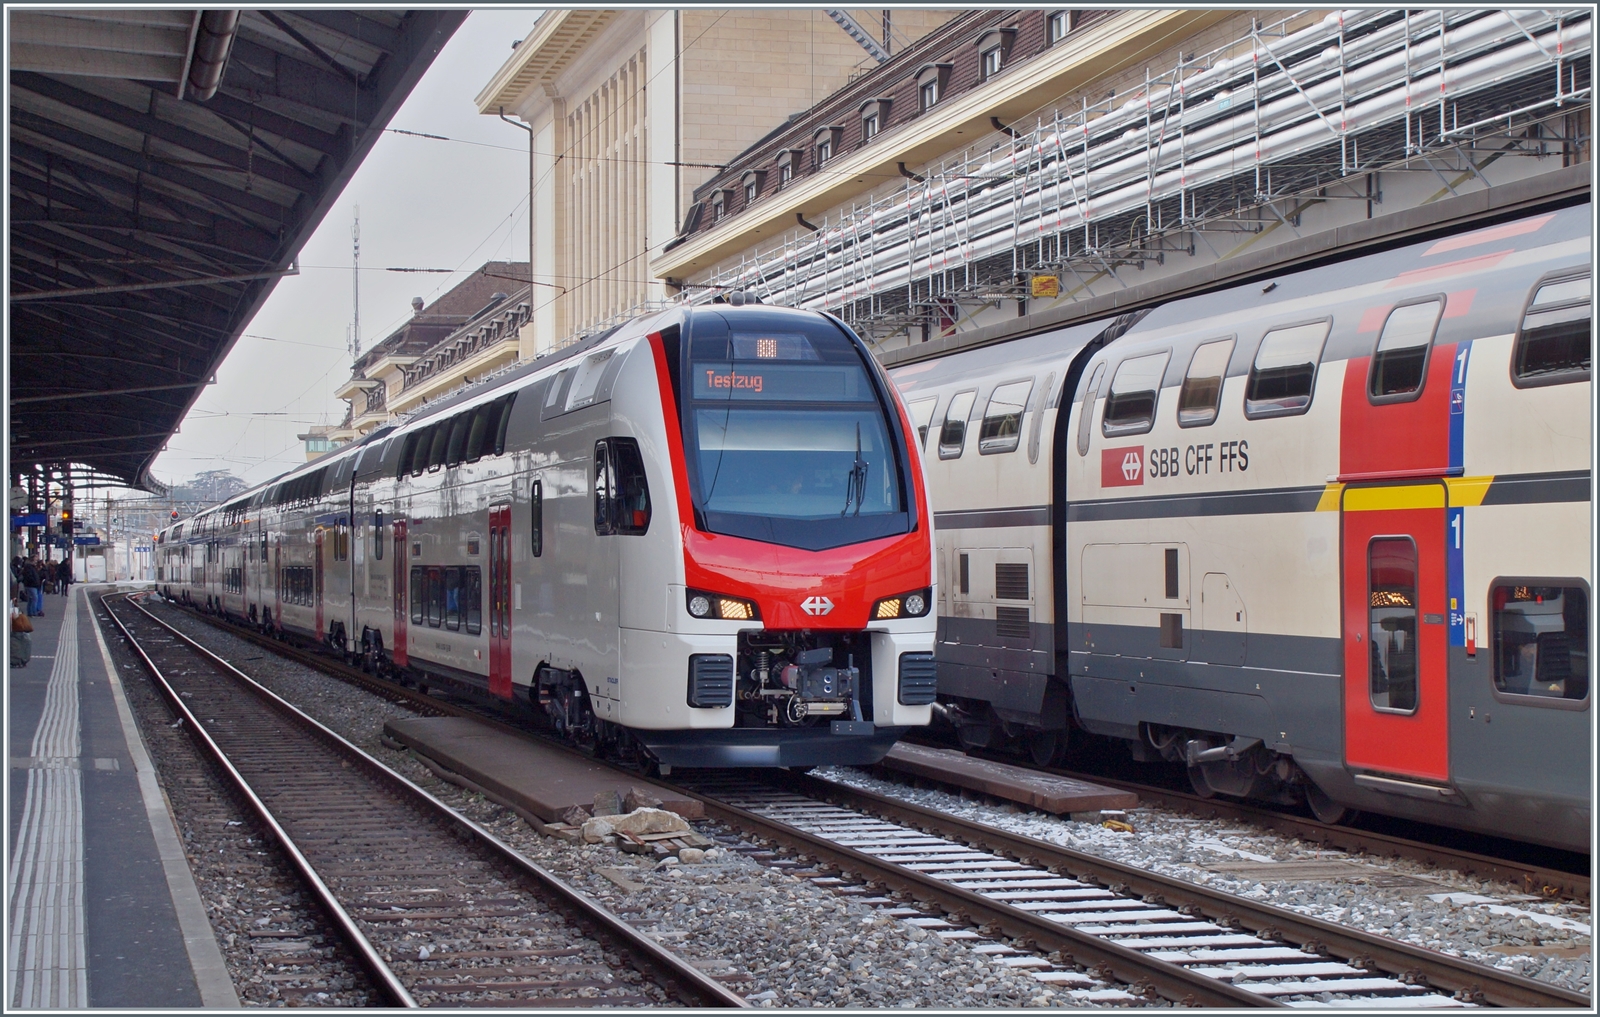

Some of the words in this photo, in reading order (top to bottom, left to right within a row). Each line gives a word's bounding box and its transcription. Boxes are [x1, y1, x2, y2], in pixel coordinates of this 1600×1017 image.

[706, 370, 763, 392] Testzug
[1457, 348, 1467, 384] 1
[1150, 448, 1179, 478] SBB
[1185, 444, 1213, 476] CFF
[1220, 440, 1249, 472] FFS
[1451, 513, 1461, 549] 1
